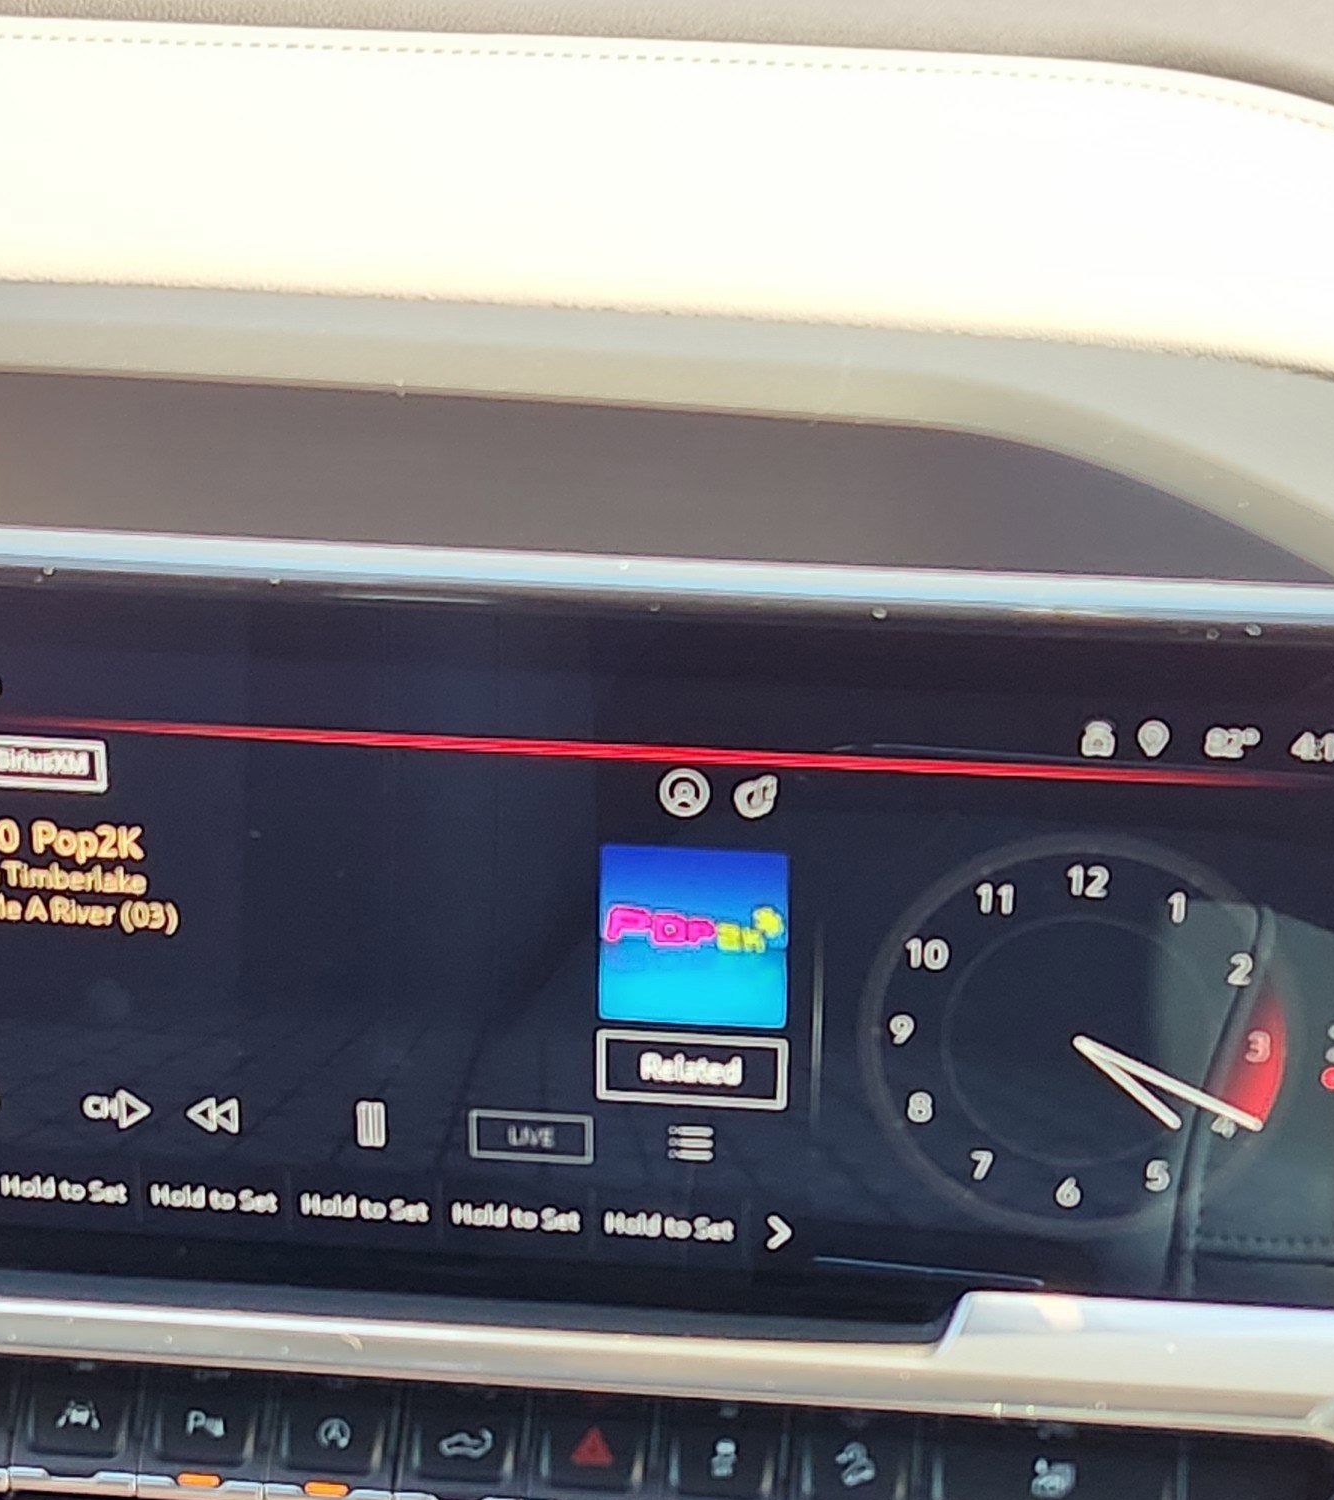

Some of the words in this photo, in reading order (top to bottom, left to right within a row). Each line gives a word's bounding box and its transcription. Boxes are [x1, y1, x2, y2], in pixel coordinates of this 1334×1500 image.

[31, 819, 144, 865] Pop2K
[1, 859, 147, 895] Timberlake
[1066, 864, 1110, 898] 12
[976, 882, 1015, 914] 11
[1168, 892, 1187, 923] 1
[24, 895, 48, 922] A
[49, 896, 116, 926] River
[120, 901, 178, 935] (03)
[906, 937, 949, 970] 10
[1227, 952, 1253, 985] 2
[888, 1015, 914, 1044] 9
[1246, 1030, 1271, 1062] 3
[640, 1052, 743, 1086] Related
[907, 1091, 934, 1123] 8
[507, 1124, 556, 1149] LIVE
[970, 1149, 993, 1181] 7
[1145, 1160, 1169, 1191] 5
[0, 1174, 56, 1200] Hold
[58, 1179, 87, 1201] to
[88, 1180, 128, 1204] Set
[150, 1183, 206, 1209] Hold
[208, 1188, 237, 1211] to
[238, 1189, 279, 1213] Set
[1055, 1176, 1082, 1207] 6
[300, 1192, 357, 1218] Hold
[359, 1197, 387, 1220] to
[389, 1198, 430, 1223] Set
[451, 1201, 509, 1228] Hold
[511, 1206, 539, 1230] to
[541, 1207, 581, 1233] Set
[603, 1211, 662, 1238] Hold
[664, 1215, 692, 1240] to
[694, 1216, 735, 1242] Set
